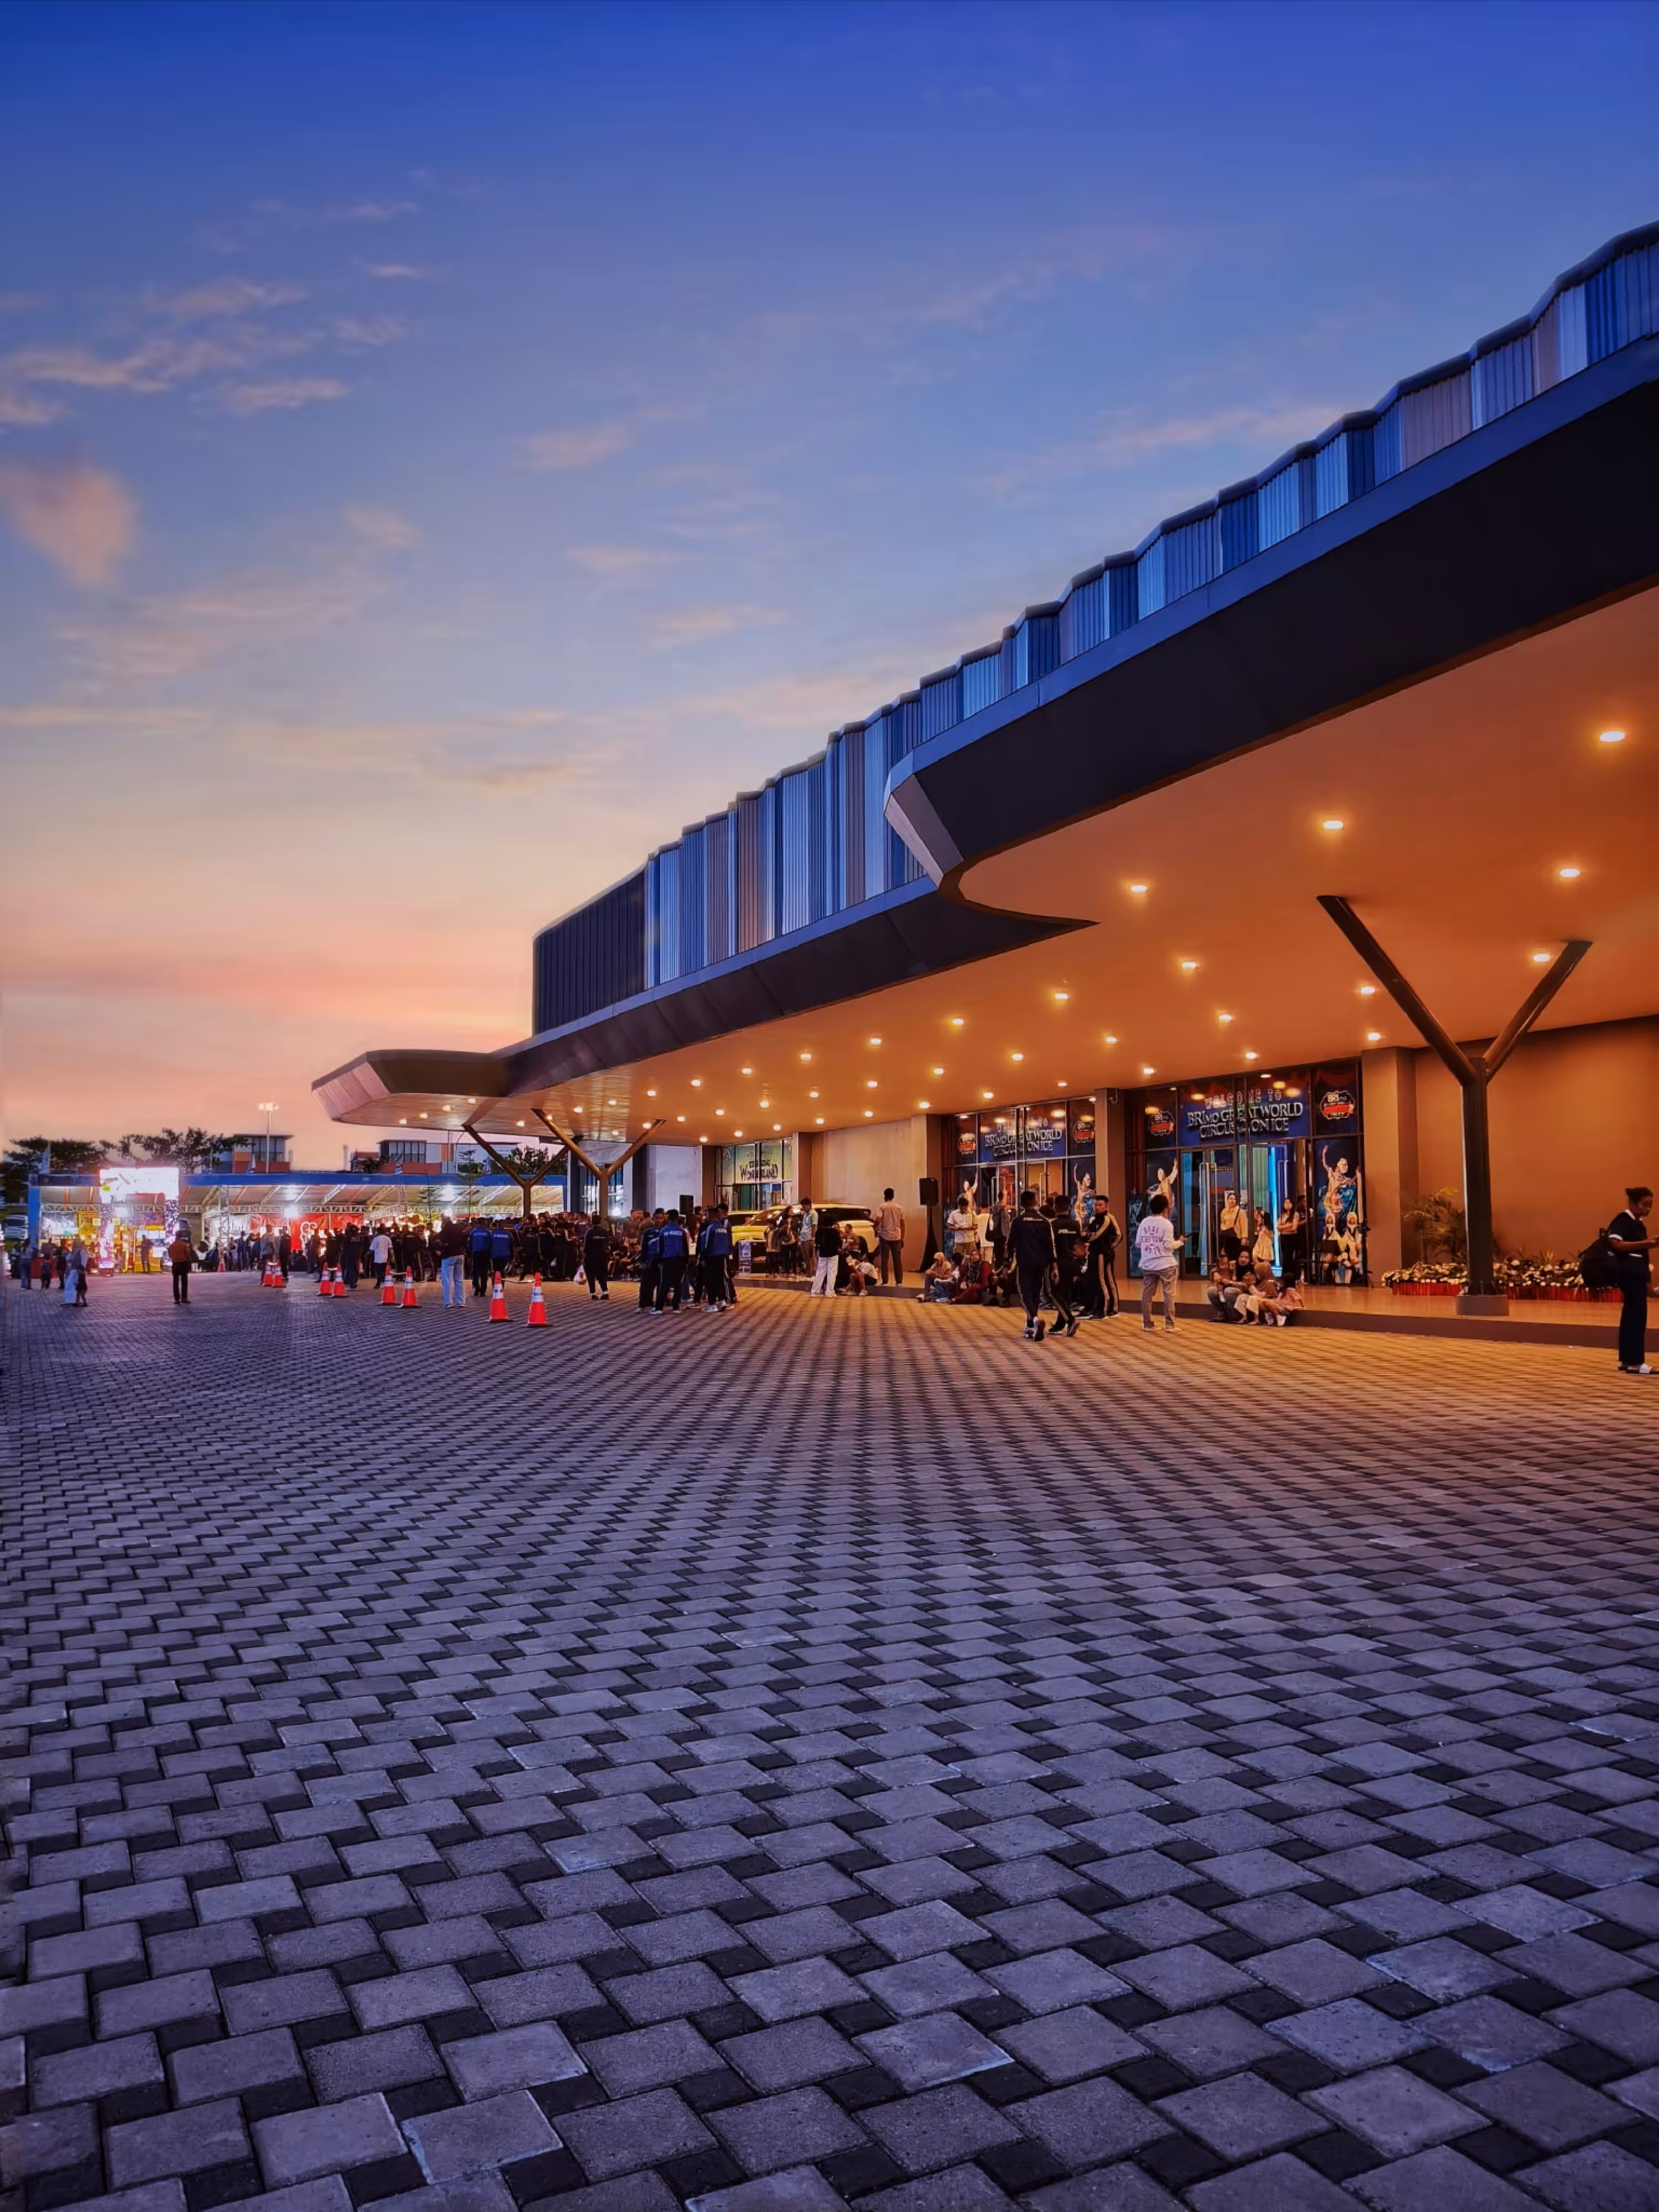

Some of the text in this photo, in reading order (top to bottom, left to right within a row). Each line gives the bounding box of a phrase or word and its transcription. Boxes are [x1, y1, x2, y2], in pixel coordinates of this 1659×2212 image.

[1267, 1088, 1282, 1102] TO
[1259, 1102, 1303, 1118] WORLD
[1250, 1118, 1269, 1132] ON
[1270, 1118, 1290, 1131] ICE
[1032, 1129, 1062, 1141] WORLD
